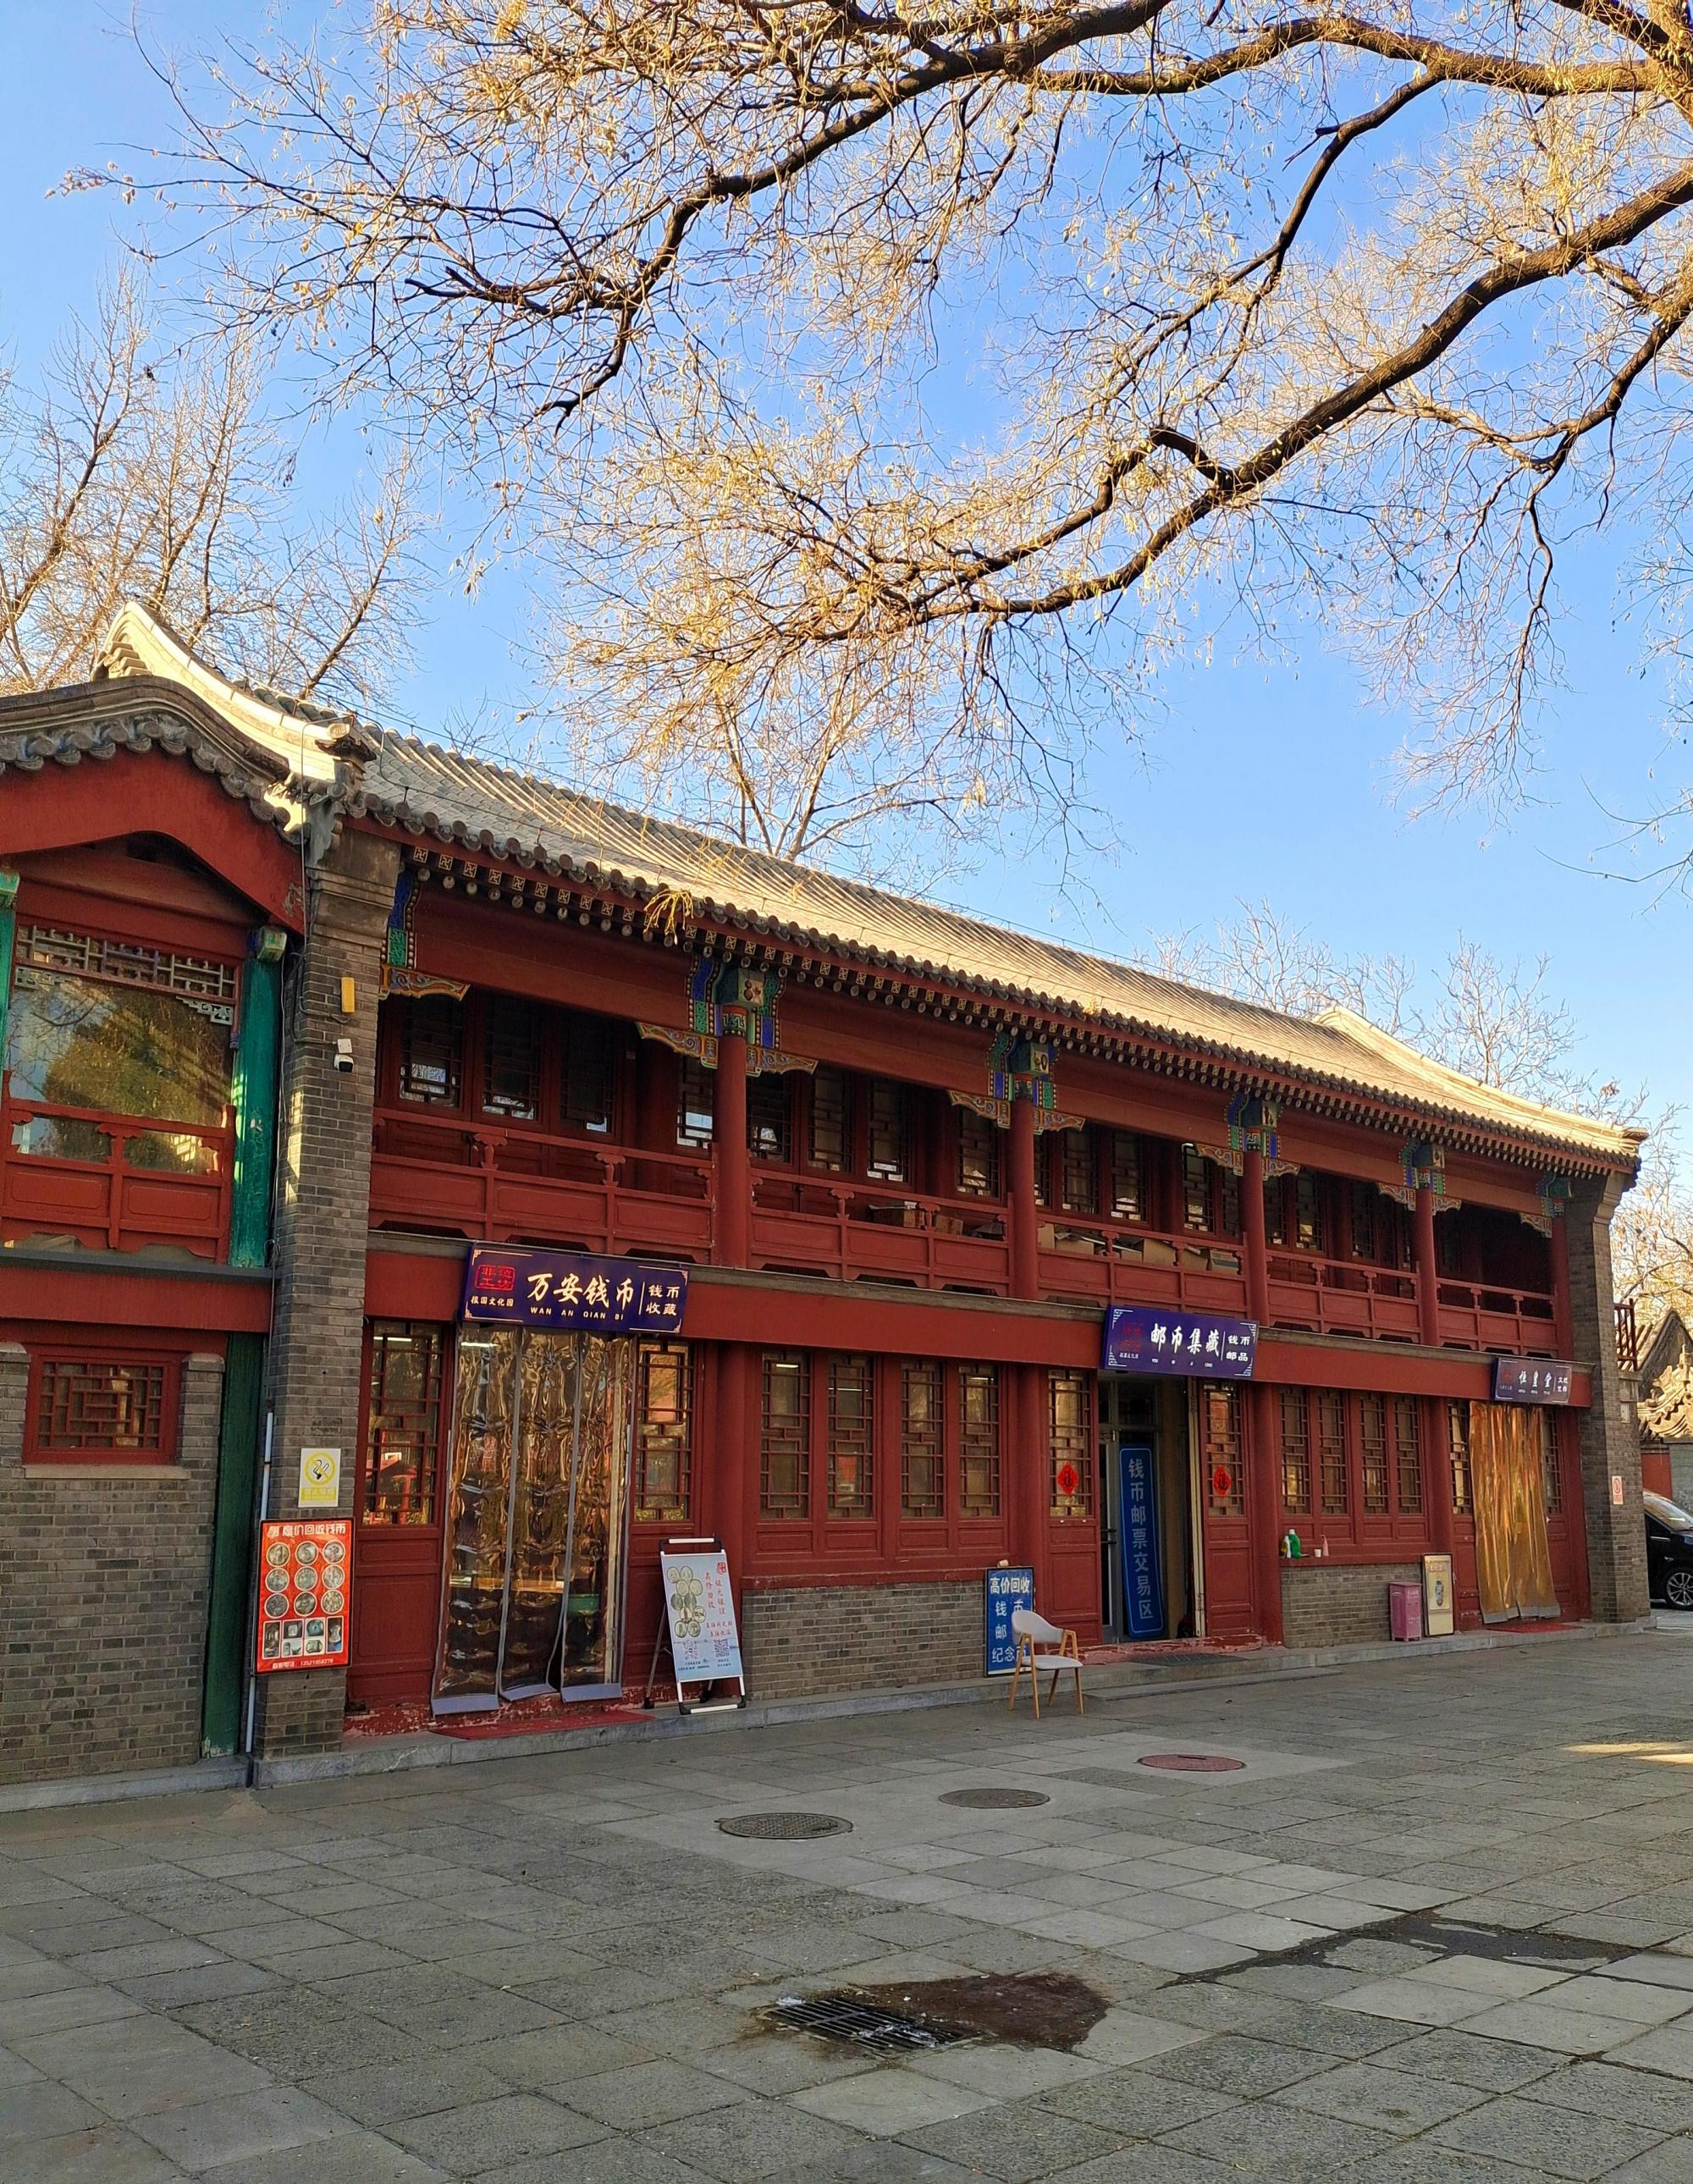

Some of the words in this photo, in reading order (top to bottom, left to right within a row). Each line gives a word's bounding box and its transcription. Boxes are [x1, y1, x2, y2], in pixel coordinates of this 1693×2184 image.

[527, 1272, 634, 1311] 万安钱币
[648, 1283, 681, 1299] 钱币
[530, 1306, 552, 1315] WAN
[583, 1310, 606, 1319] QIAN
[646, 1301, 678, 1316] 收藏
[1150, 1322, 1220, 1357] 邮币集藏
[1227, 1334, 1250, 1346] 钱币
[1226, 1351, 1249, 1362] 邮品
[1128, 1458, 1154, 1619] 钱币邮票交易区
[990, 1576, 1030, 1595] 高价回收
